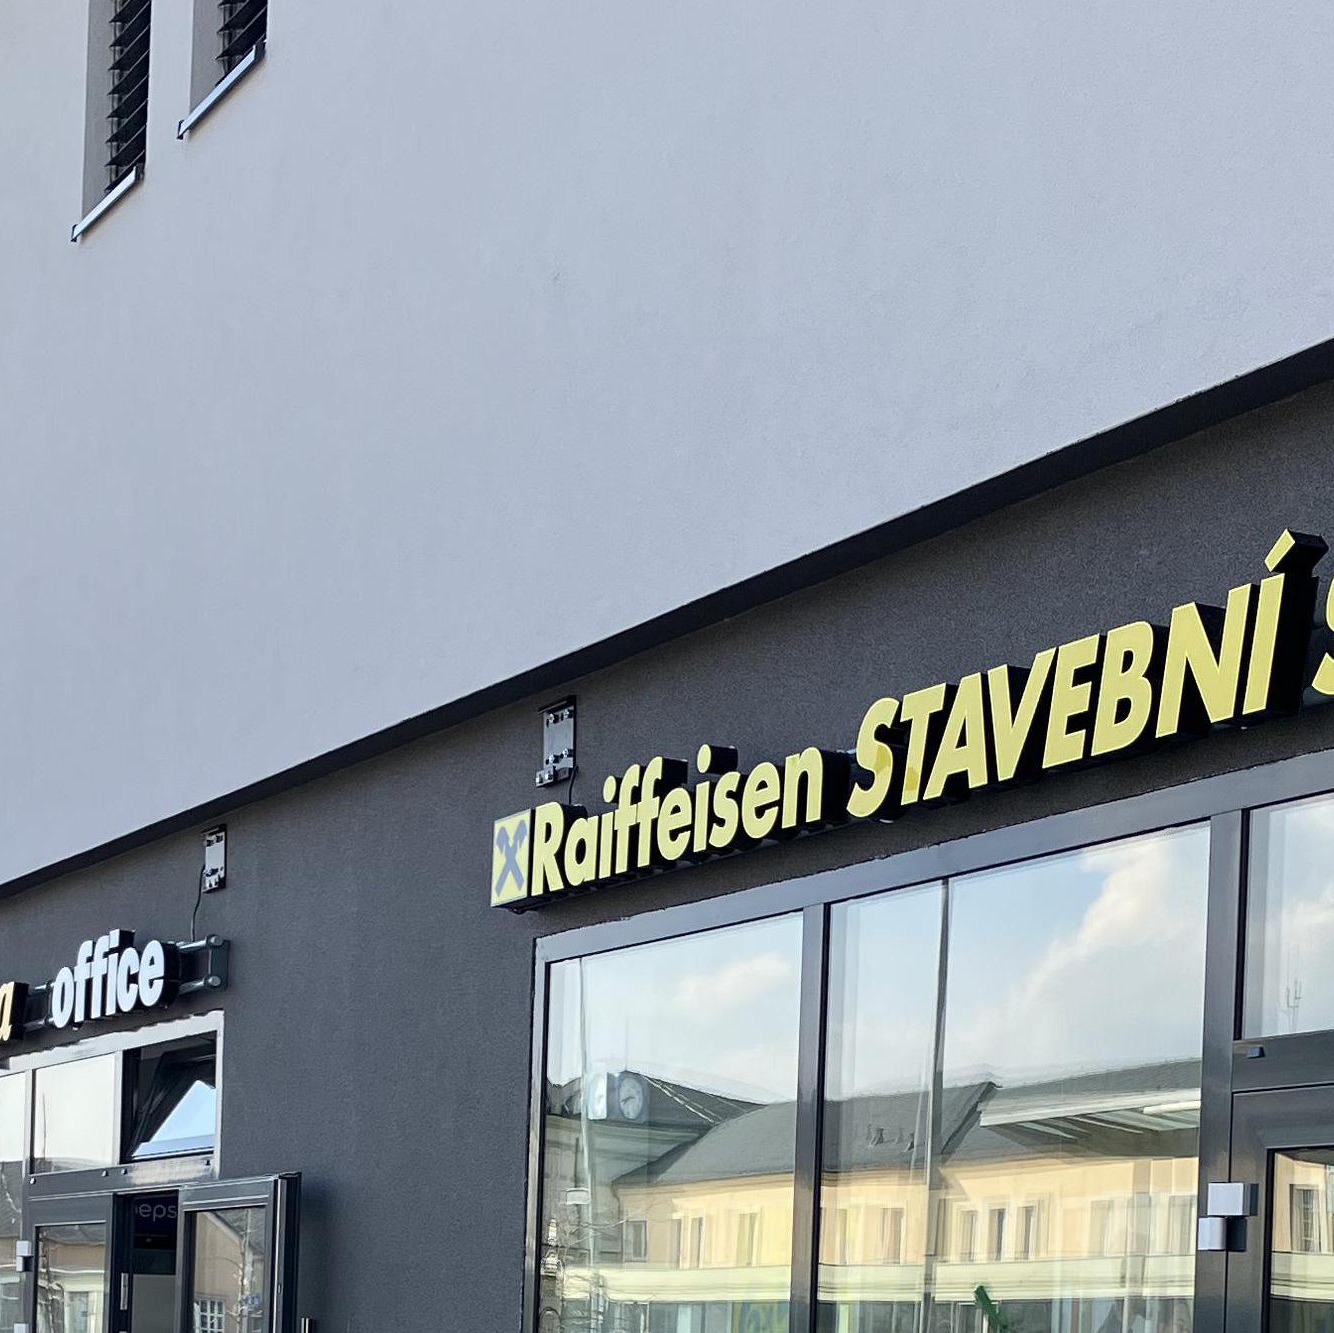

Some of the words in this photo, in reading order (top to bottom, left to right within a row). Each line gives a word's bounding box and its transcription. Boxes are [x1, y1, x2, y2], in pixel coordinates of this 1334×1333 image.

[529, 746, 822, 896] Raiffeisen
[847, 528, 1295, 818] STAVEBNÍ
[51, 929, 166, 1029] office
[134, 1203, 178, 1222] eps
